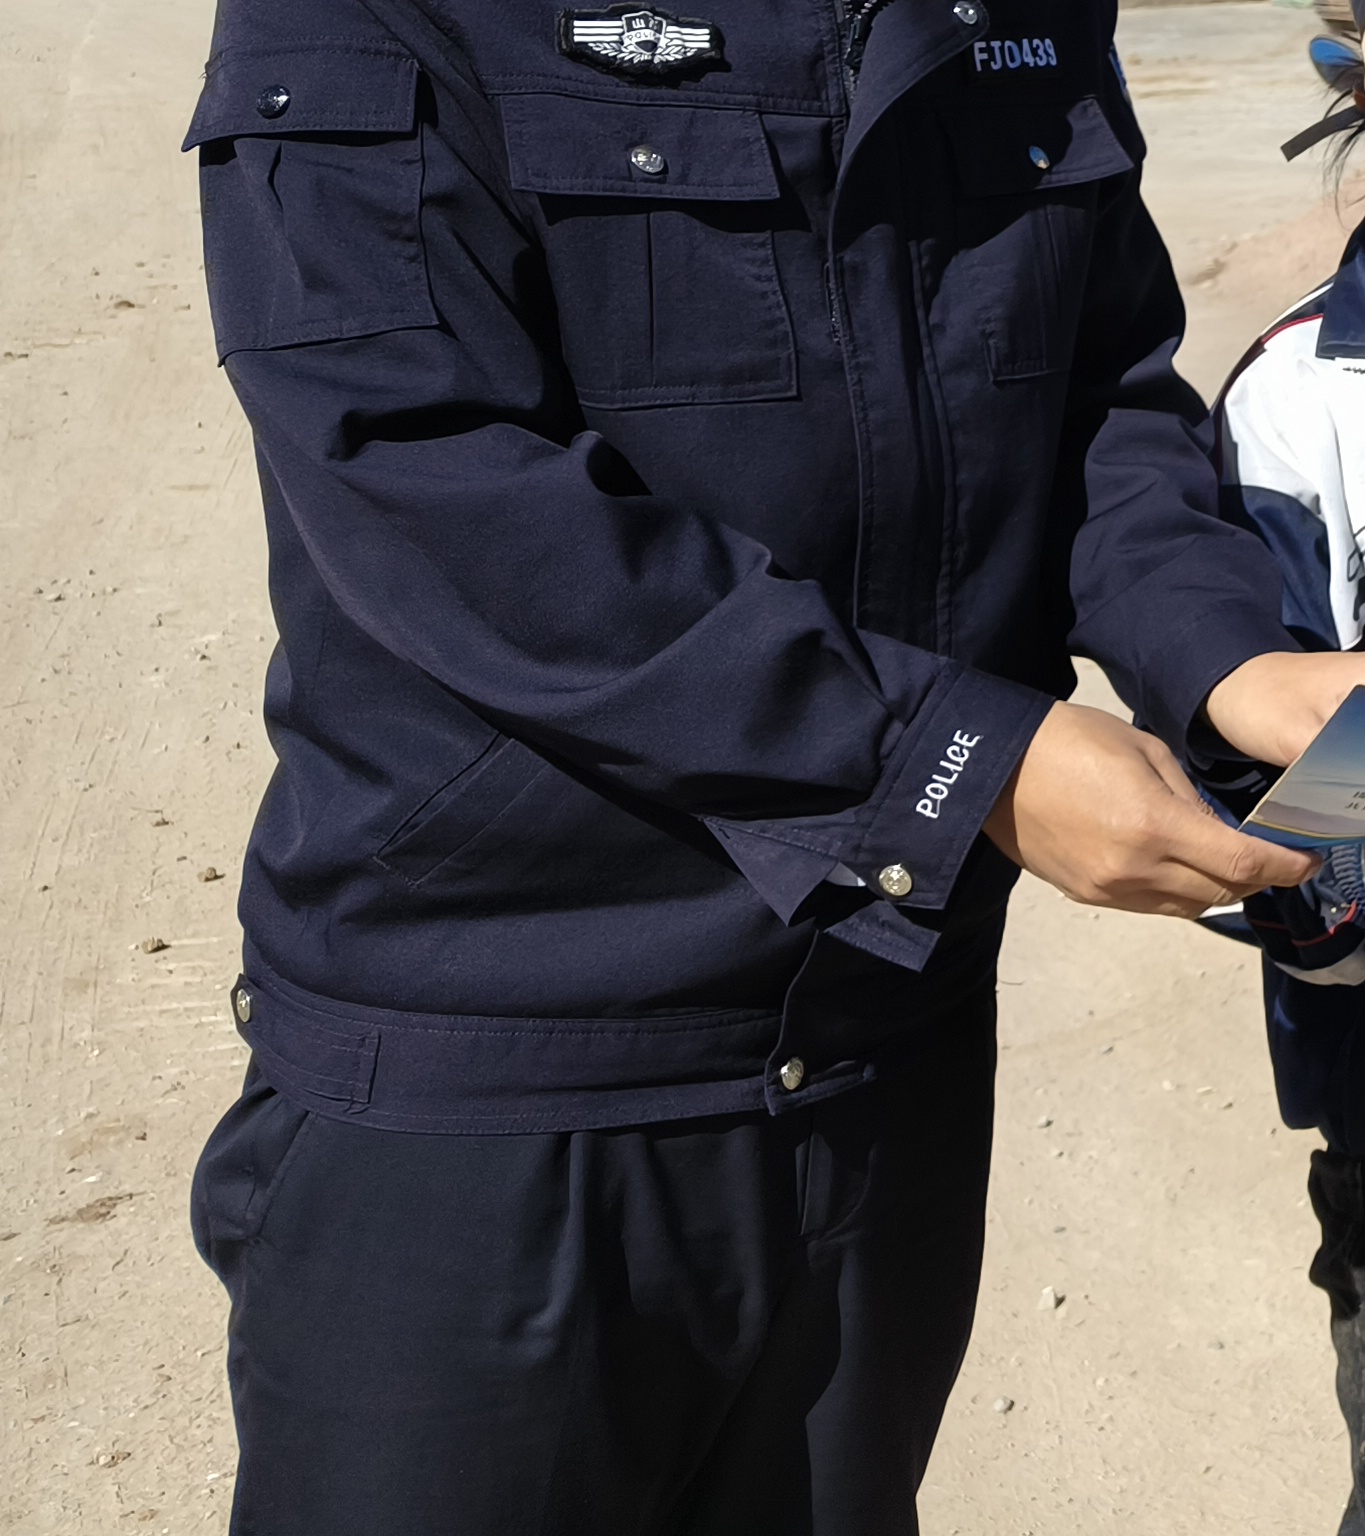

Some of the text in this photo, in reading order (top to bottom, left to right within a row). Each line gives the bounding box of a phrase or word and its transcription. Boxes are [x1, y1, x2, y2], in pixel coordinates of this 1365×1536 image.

[626, 31, 660, 43] POLI
[973, 38, 1058, 73] FJ0439
[916, 729, 983, 819] POLICE
